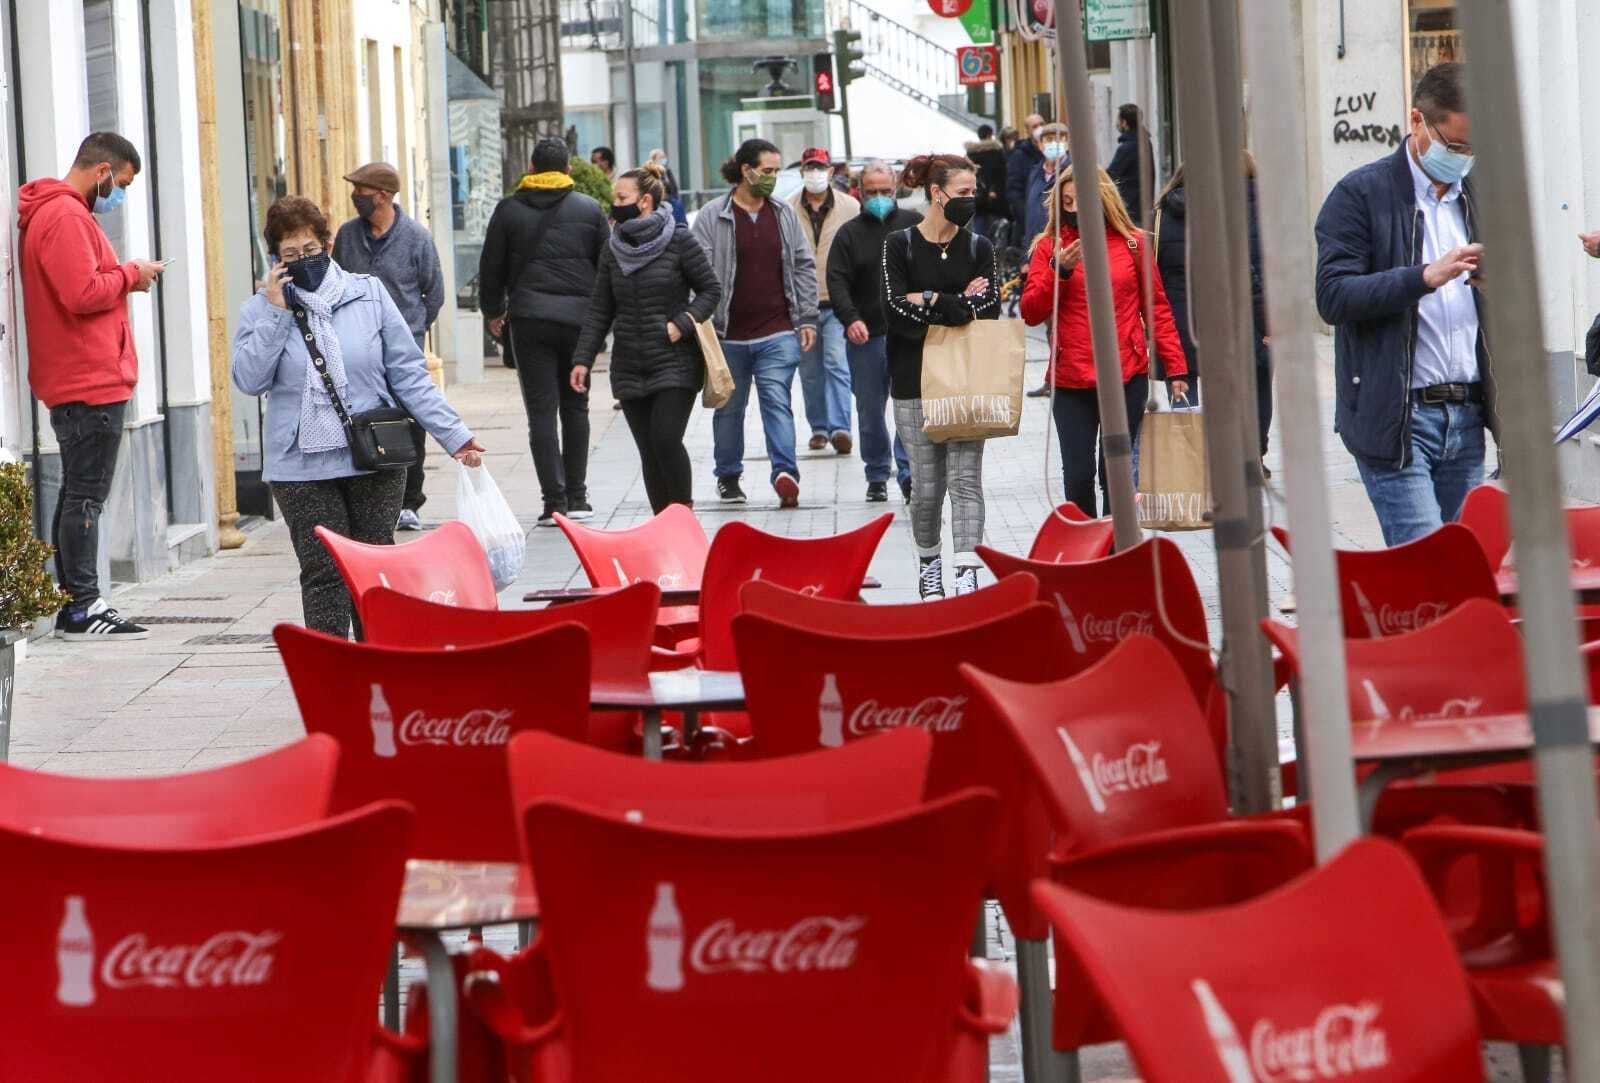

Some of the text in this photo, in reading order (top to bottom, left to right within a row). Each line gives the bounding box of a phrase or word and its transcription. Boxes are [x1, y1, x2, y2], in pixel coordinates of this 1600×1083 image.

[1333, 91, 1376, 117] LUV
[399, 708, 514, 747] Coca-Cola
[849, 695, 968, 736] Coca-Cola
[1092, 739, 1169, 797] Coca-Cola
[101, 929, 283, 990] Coca-Cola
[691, 914, 868, 974] Coca-Cola
